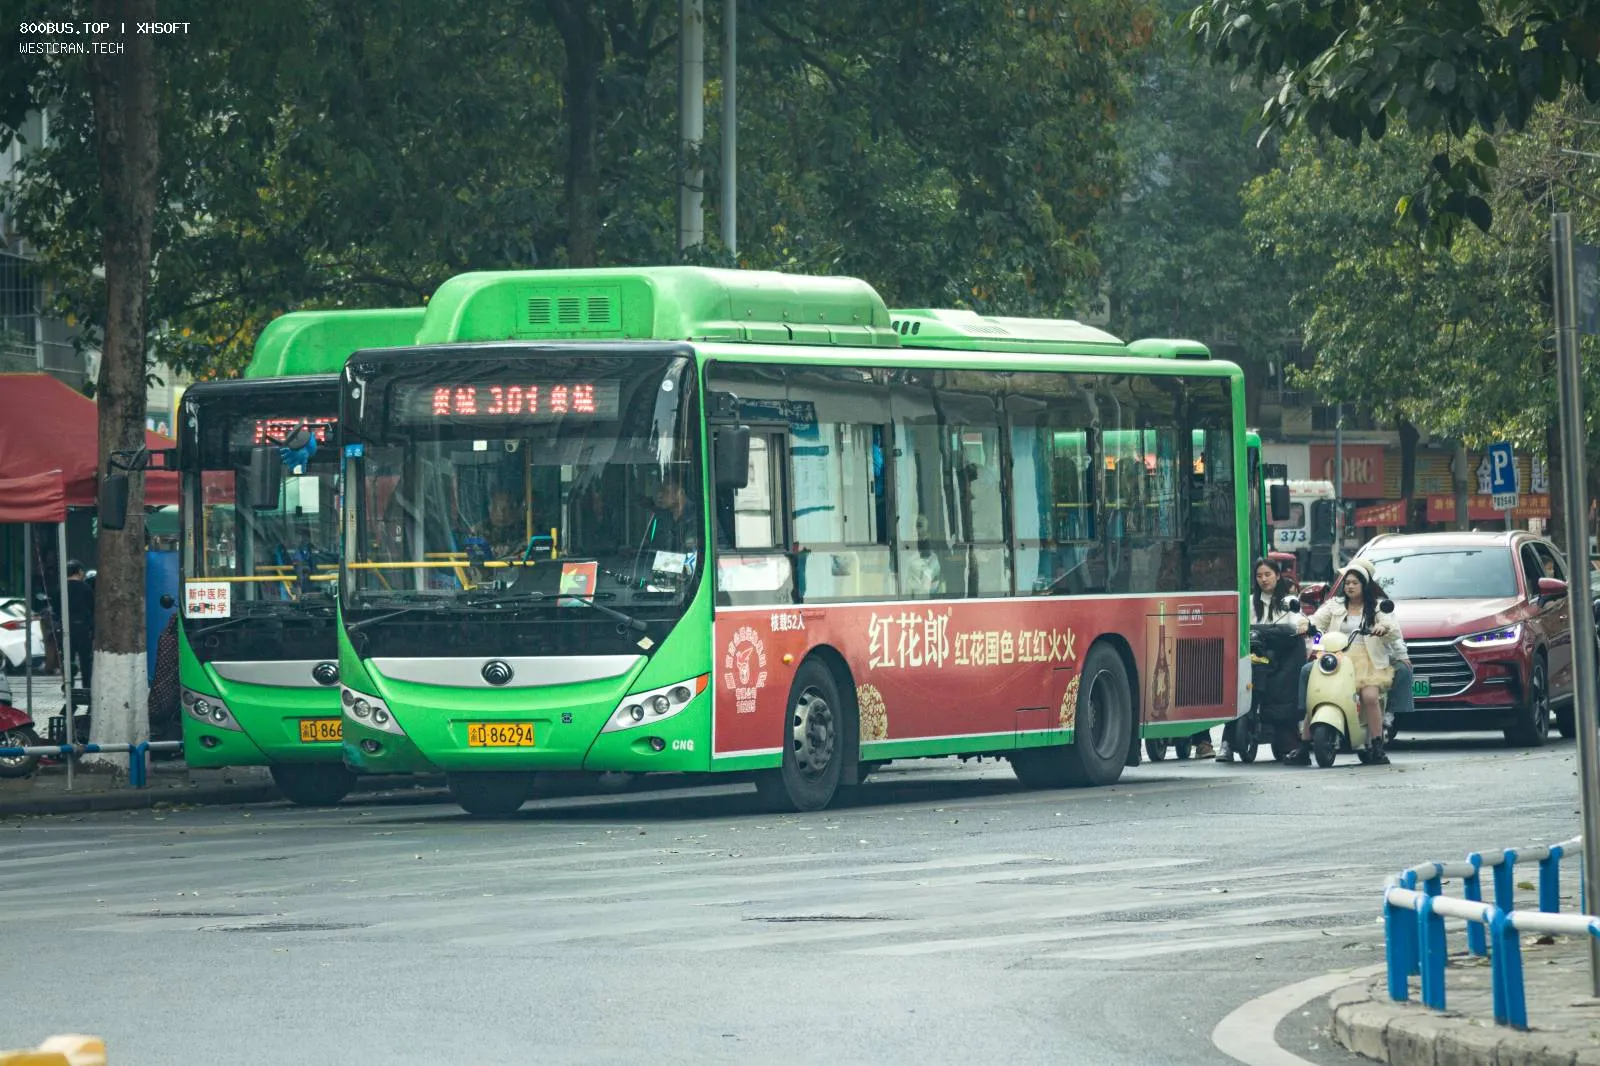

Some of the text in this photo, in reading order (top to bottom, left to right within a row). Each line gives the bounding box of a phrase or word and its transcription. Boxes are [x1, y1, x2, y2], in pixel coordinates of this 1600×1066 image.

[488, 386, 537, 414] 301
[1492, 450, 1508, 485] P
[1280, 531, 1306, 542] 373
[189, 588, 227, 600] 新中医院
[770, 612, 806, 632] 核载52人
[868, 609, 1077, 671] 红花郎 红花国色 红红火火
[672, 739, 695, 751] CNG
